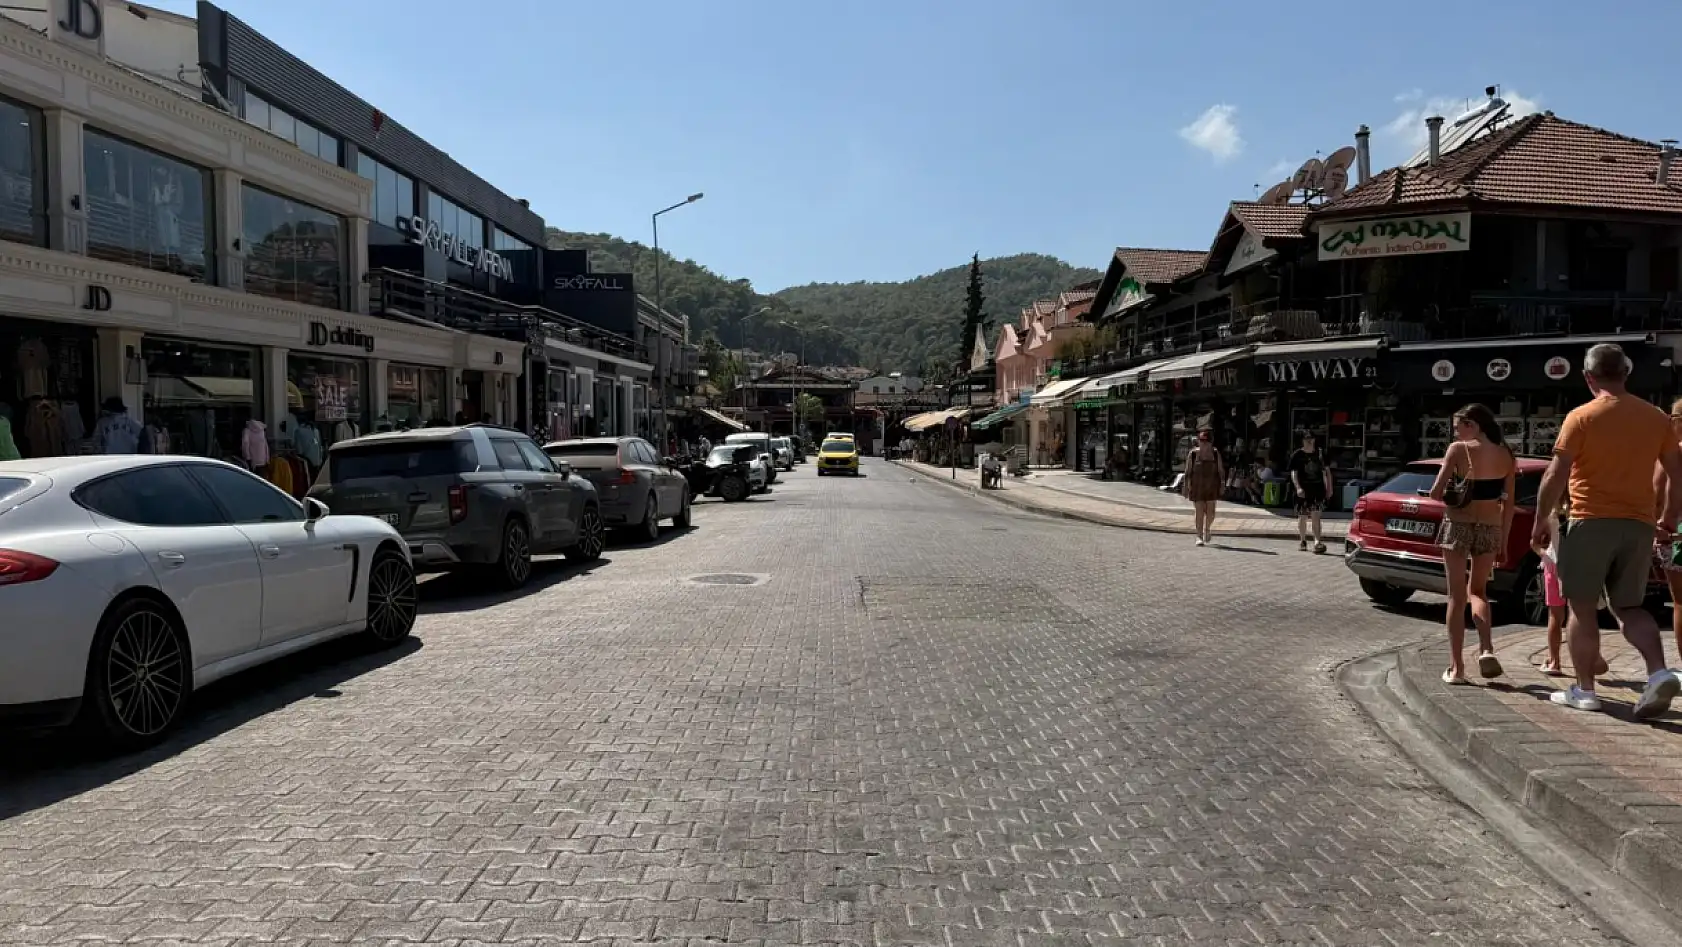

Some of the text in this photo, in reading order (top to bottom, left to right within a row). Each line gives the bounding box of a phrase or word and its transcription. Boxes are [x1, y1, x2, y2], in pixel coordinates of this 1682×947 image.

[411, 215, 515, 284] SKYFALL ARENA
[1386, 242, 1411, 253] Indian
[1412, 240, 1447, 252] Cuisine
[554, 275, 624, 290] SKYFALL
[82, 285, 112, 311] JD
[307, 322, 328, 345] JD
[1267, 358, 1378, 382] MY WAY 21
[317, 385, 347, 405] SALE
